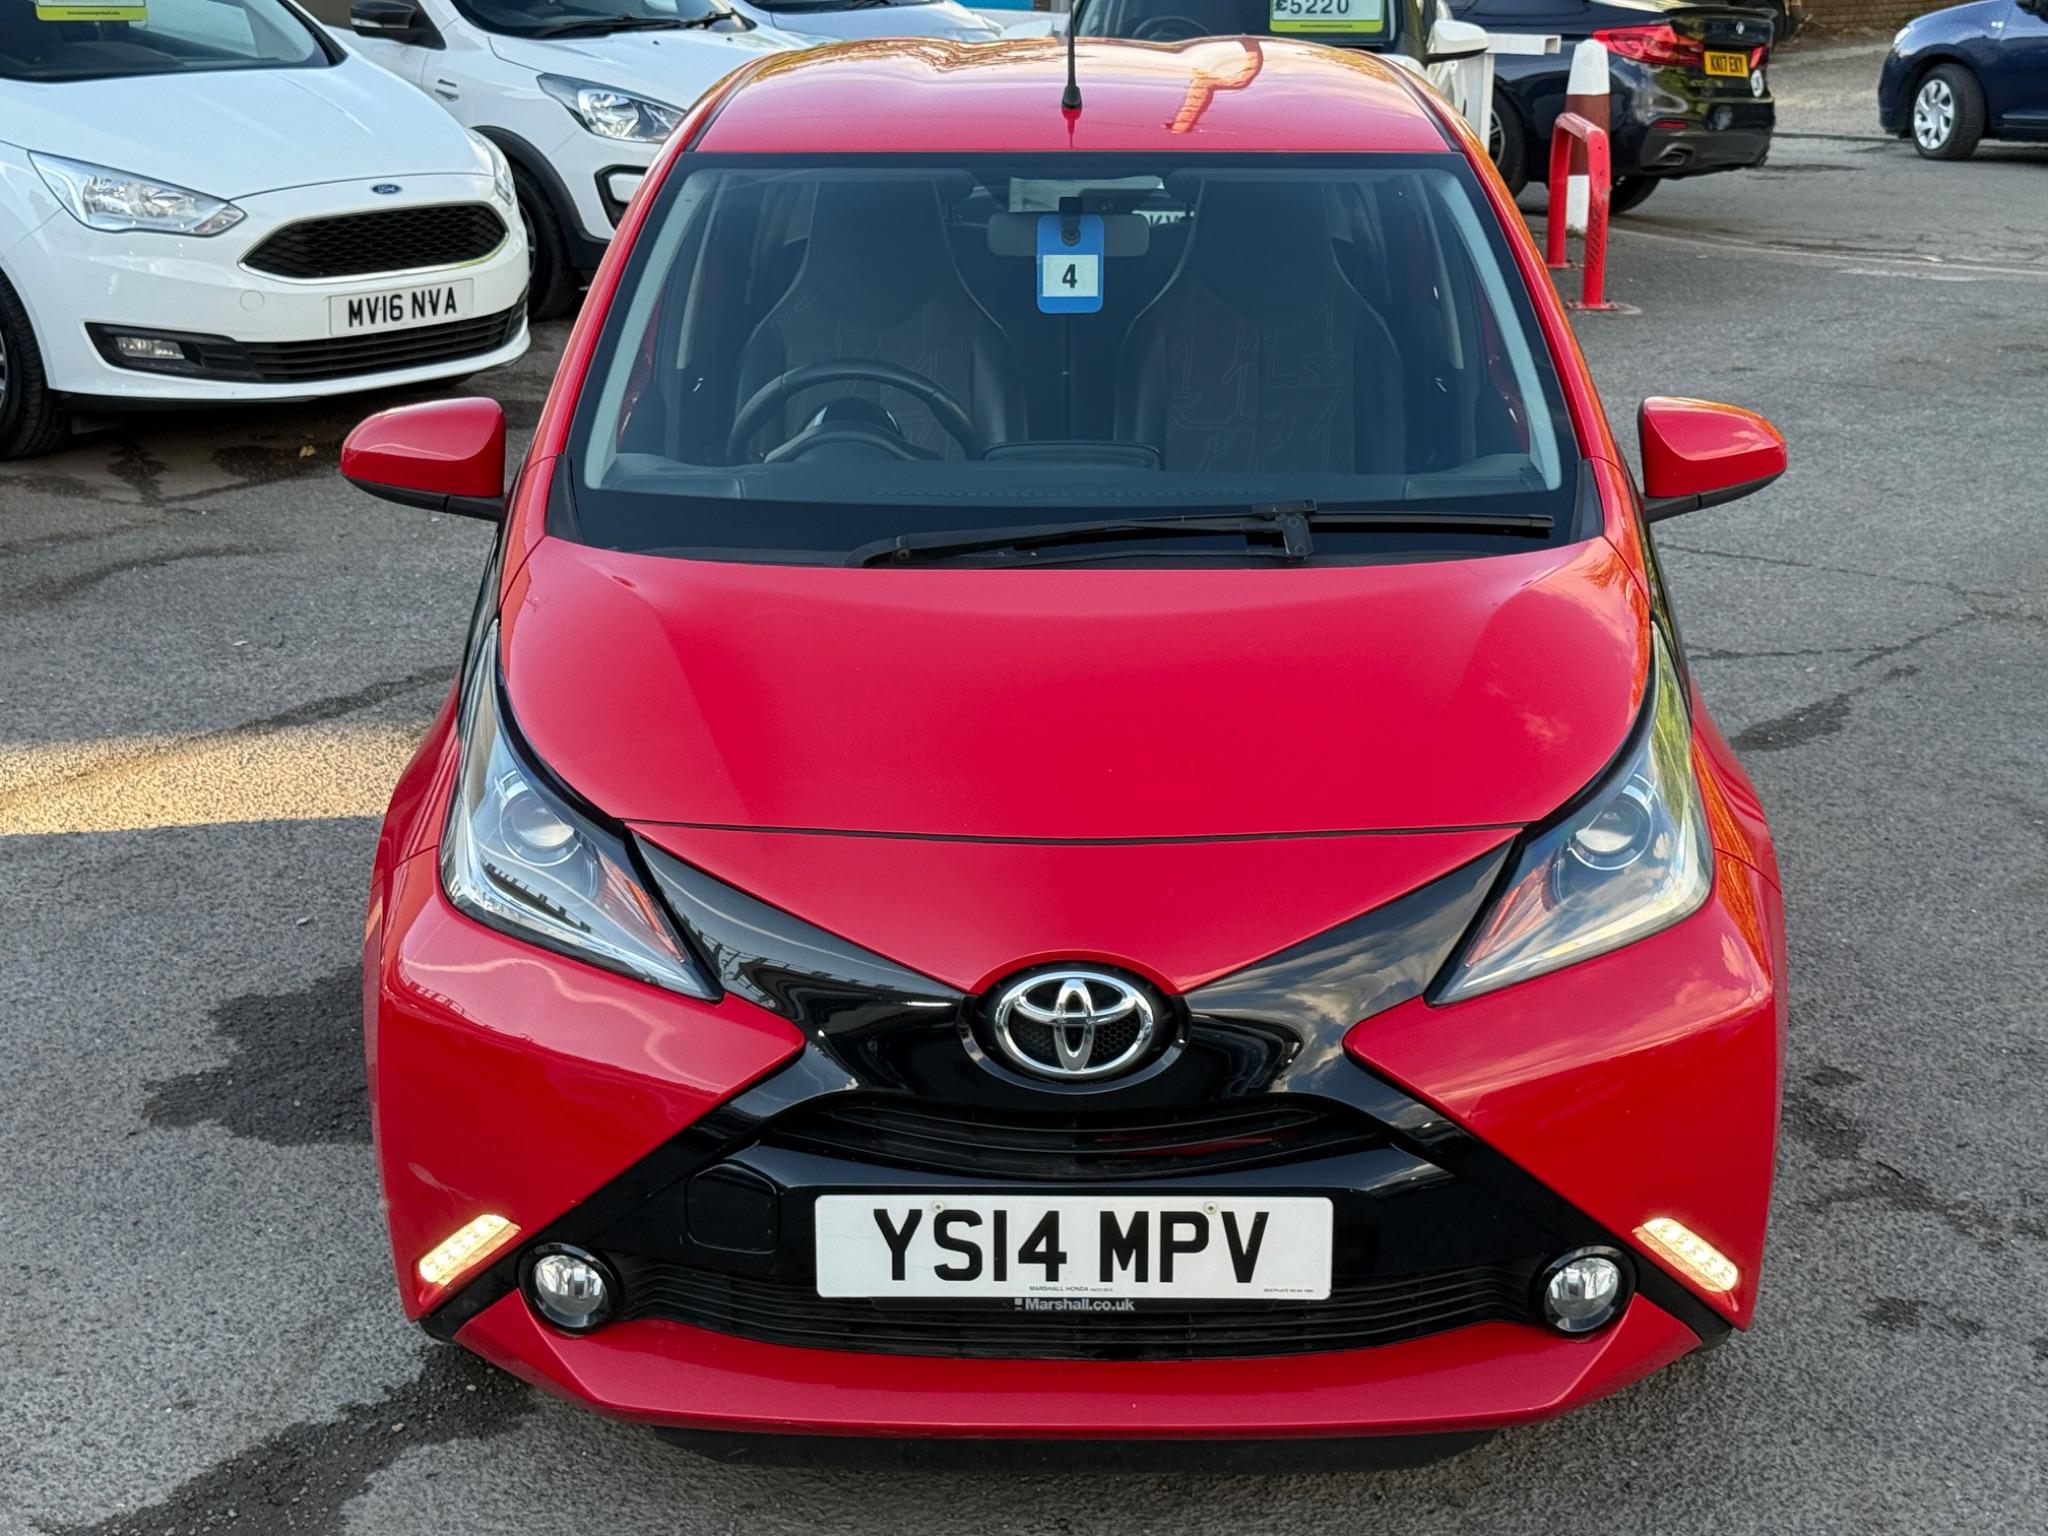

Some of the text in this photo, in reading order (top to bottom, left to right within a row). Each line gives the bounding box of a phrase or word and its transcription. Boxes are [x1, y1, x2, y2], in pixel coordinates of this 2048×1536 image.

[1275, 0, 1349, 14] £5220
[1062, 264, 1077, 288] 4
[348, 287, 457, 328] MV16 NVA
[873, 1208, 1270, 1284] YS14 MPV
[1025, 1298, 1135, 1311] Marshall.co.uk
